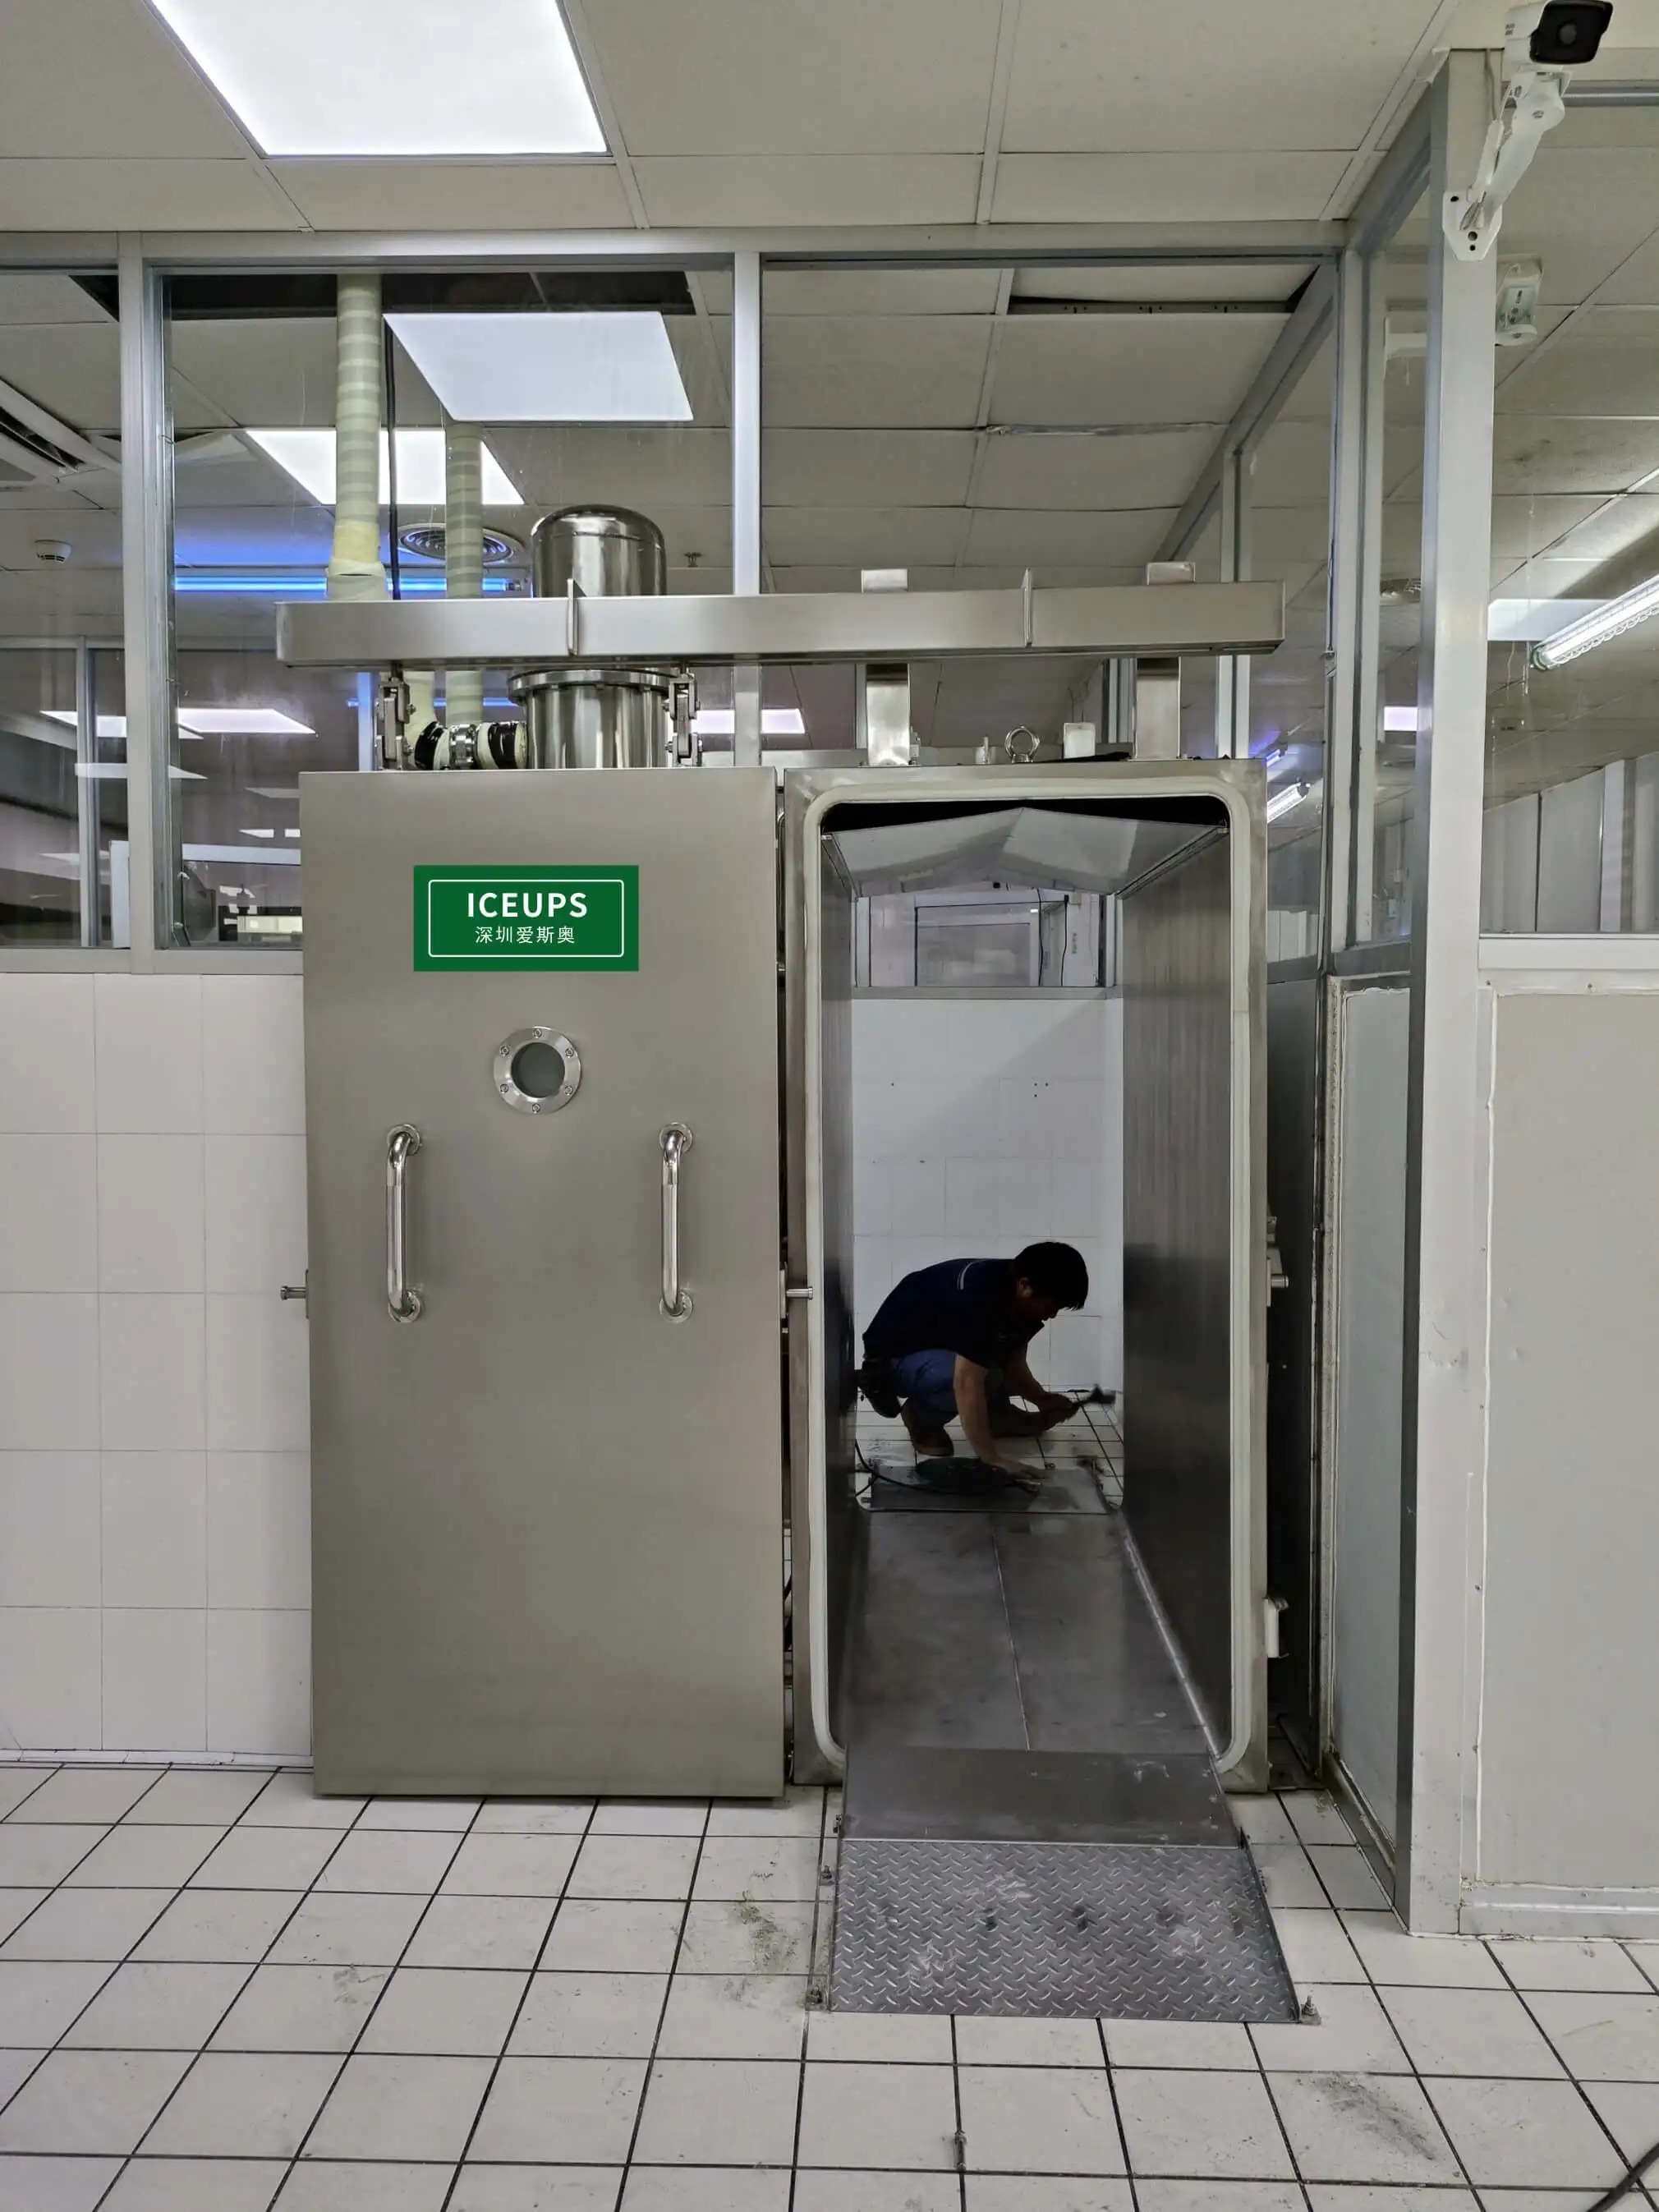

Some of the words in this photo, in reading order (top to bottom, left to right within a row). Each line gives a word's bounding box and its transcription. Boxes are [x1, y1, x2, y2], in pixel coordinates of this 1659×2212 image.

[467, 892, 588, 918] ICEUPS
[475, 926, 575, 944] 深圳爱斯奥
